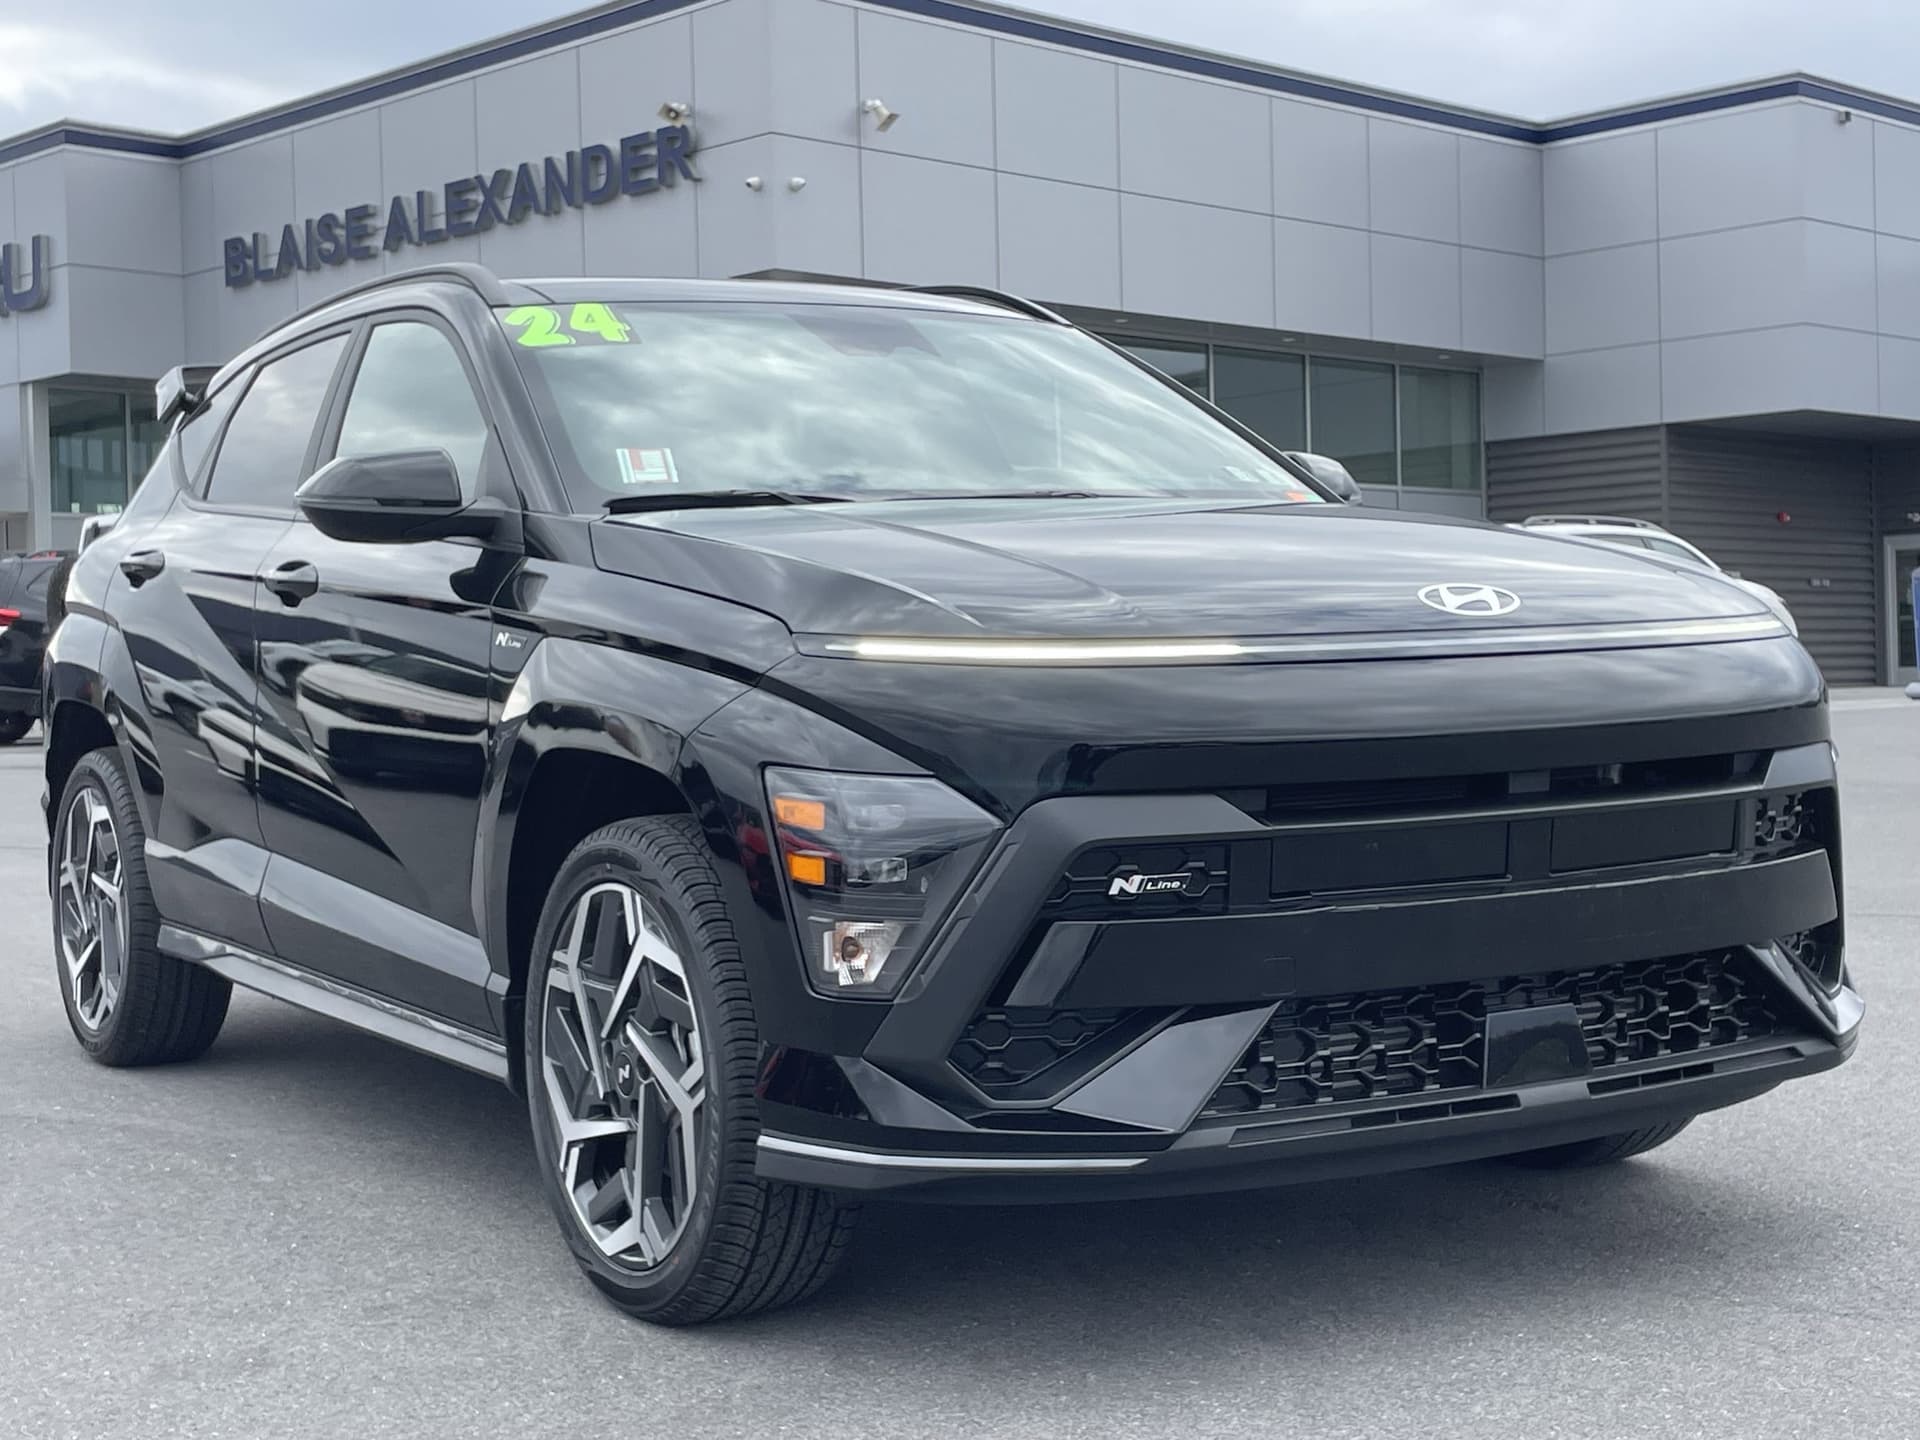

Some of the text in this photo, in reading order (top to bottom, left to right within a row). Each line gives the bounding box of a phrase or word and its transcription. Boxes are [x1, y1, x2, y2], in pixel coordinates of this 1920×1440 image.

[223, 124, 701, 289] BLAISE ALEXANDER
[0, 234, 50, 318] U
[503, 302, 631, 347] 24
[1108, 875, 1145, 895] N
